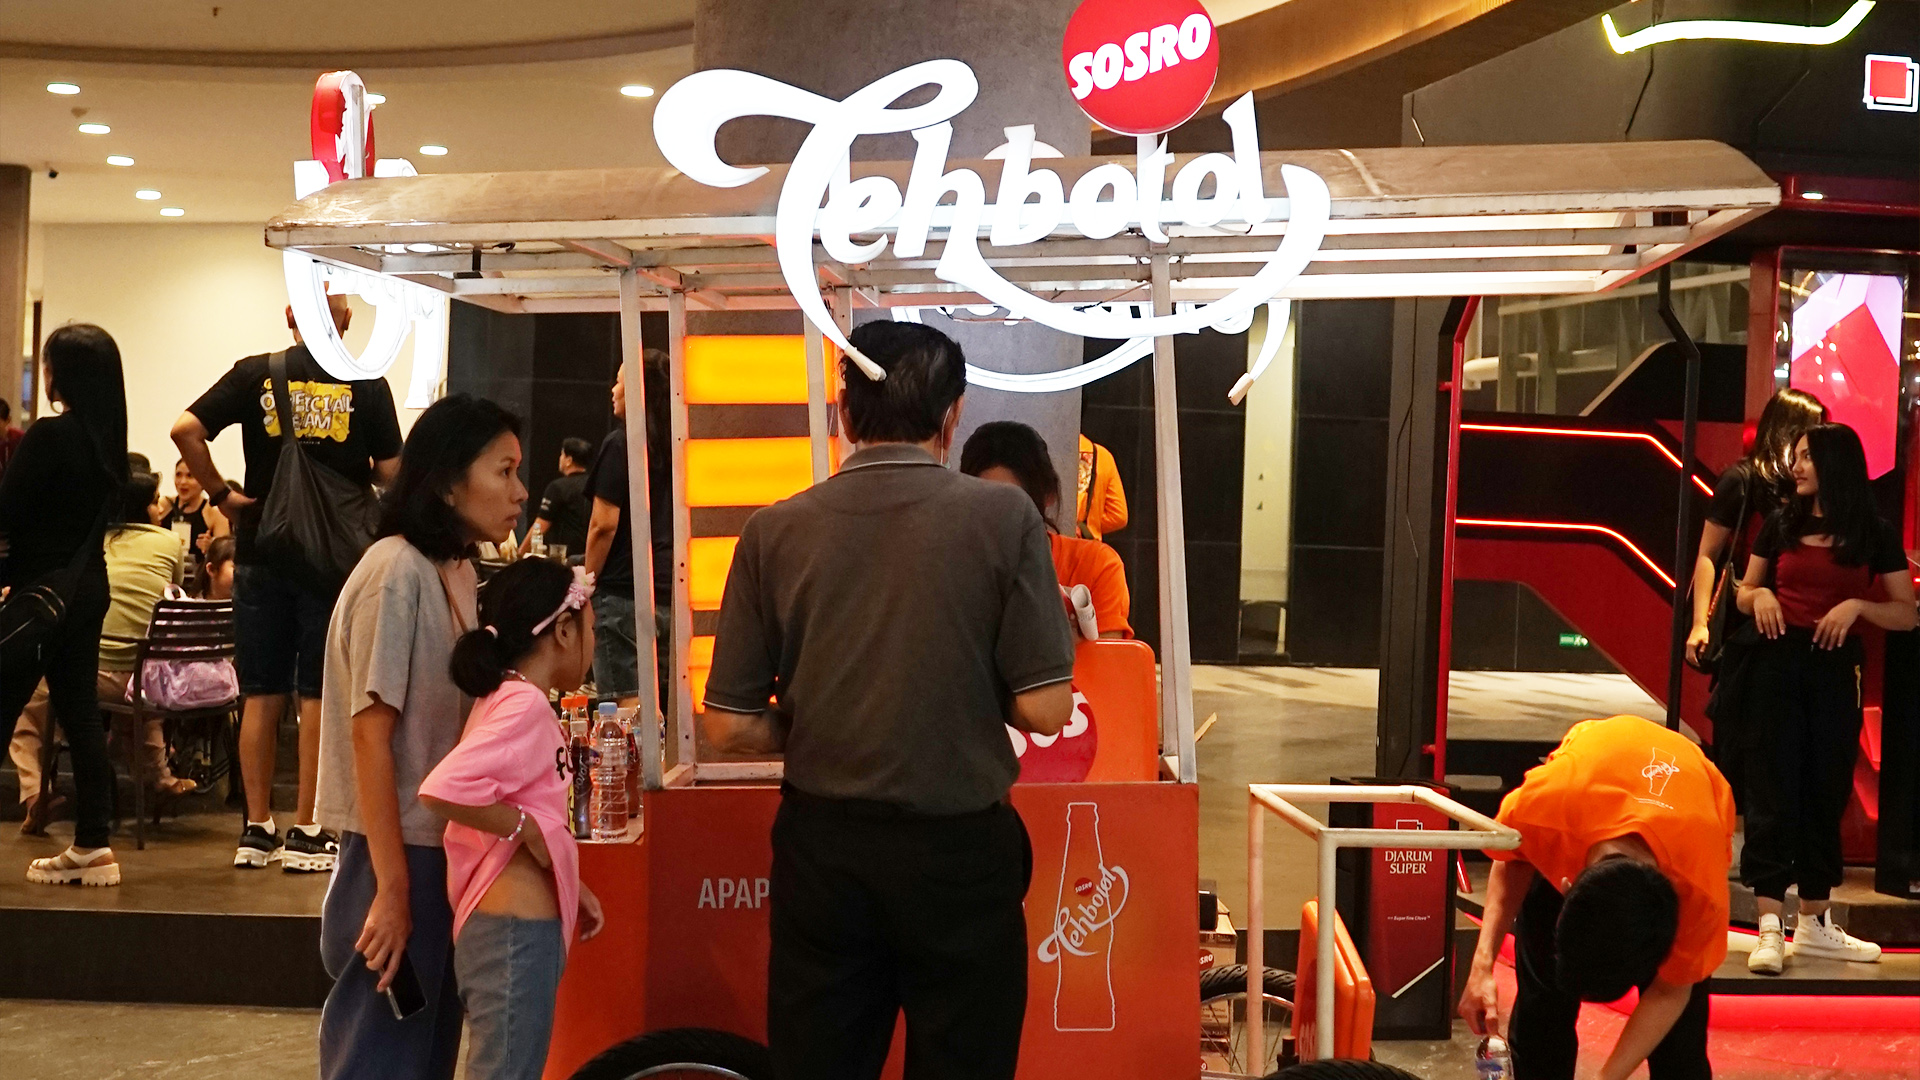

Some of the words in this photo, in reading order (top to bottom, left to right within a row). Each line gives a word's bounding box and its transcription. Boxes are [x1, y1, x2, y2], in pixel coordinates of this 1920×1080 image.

[1068, 12, 1212, 100] SOSRO
[652, 58, 1331, 381] Tehbotol
[260, 391, 355, 413] OFICIAL
[292, 411, 332, 430] EAM
[1384, 850, 1433, 862] DJARUM
[1389, 863, 1427, 874] SUPER
[697, 877, 770, 909] APAP
[1200, 954, 1213, 965] SRO
